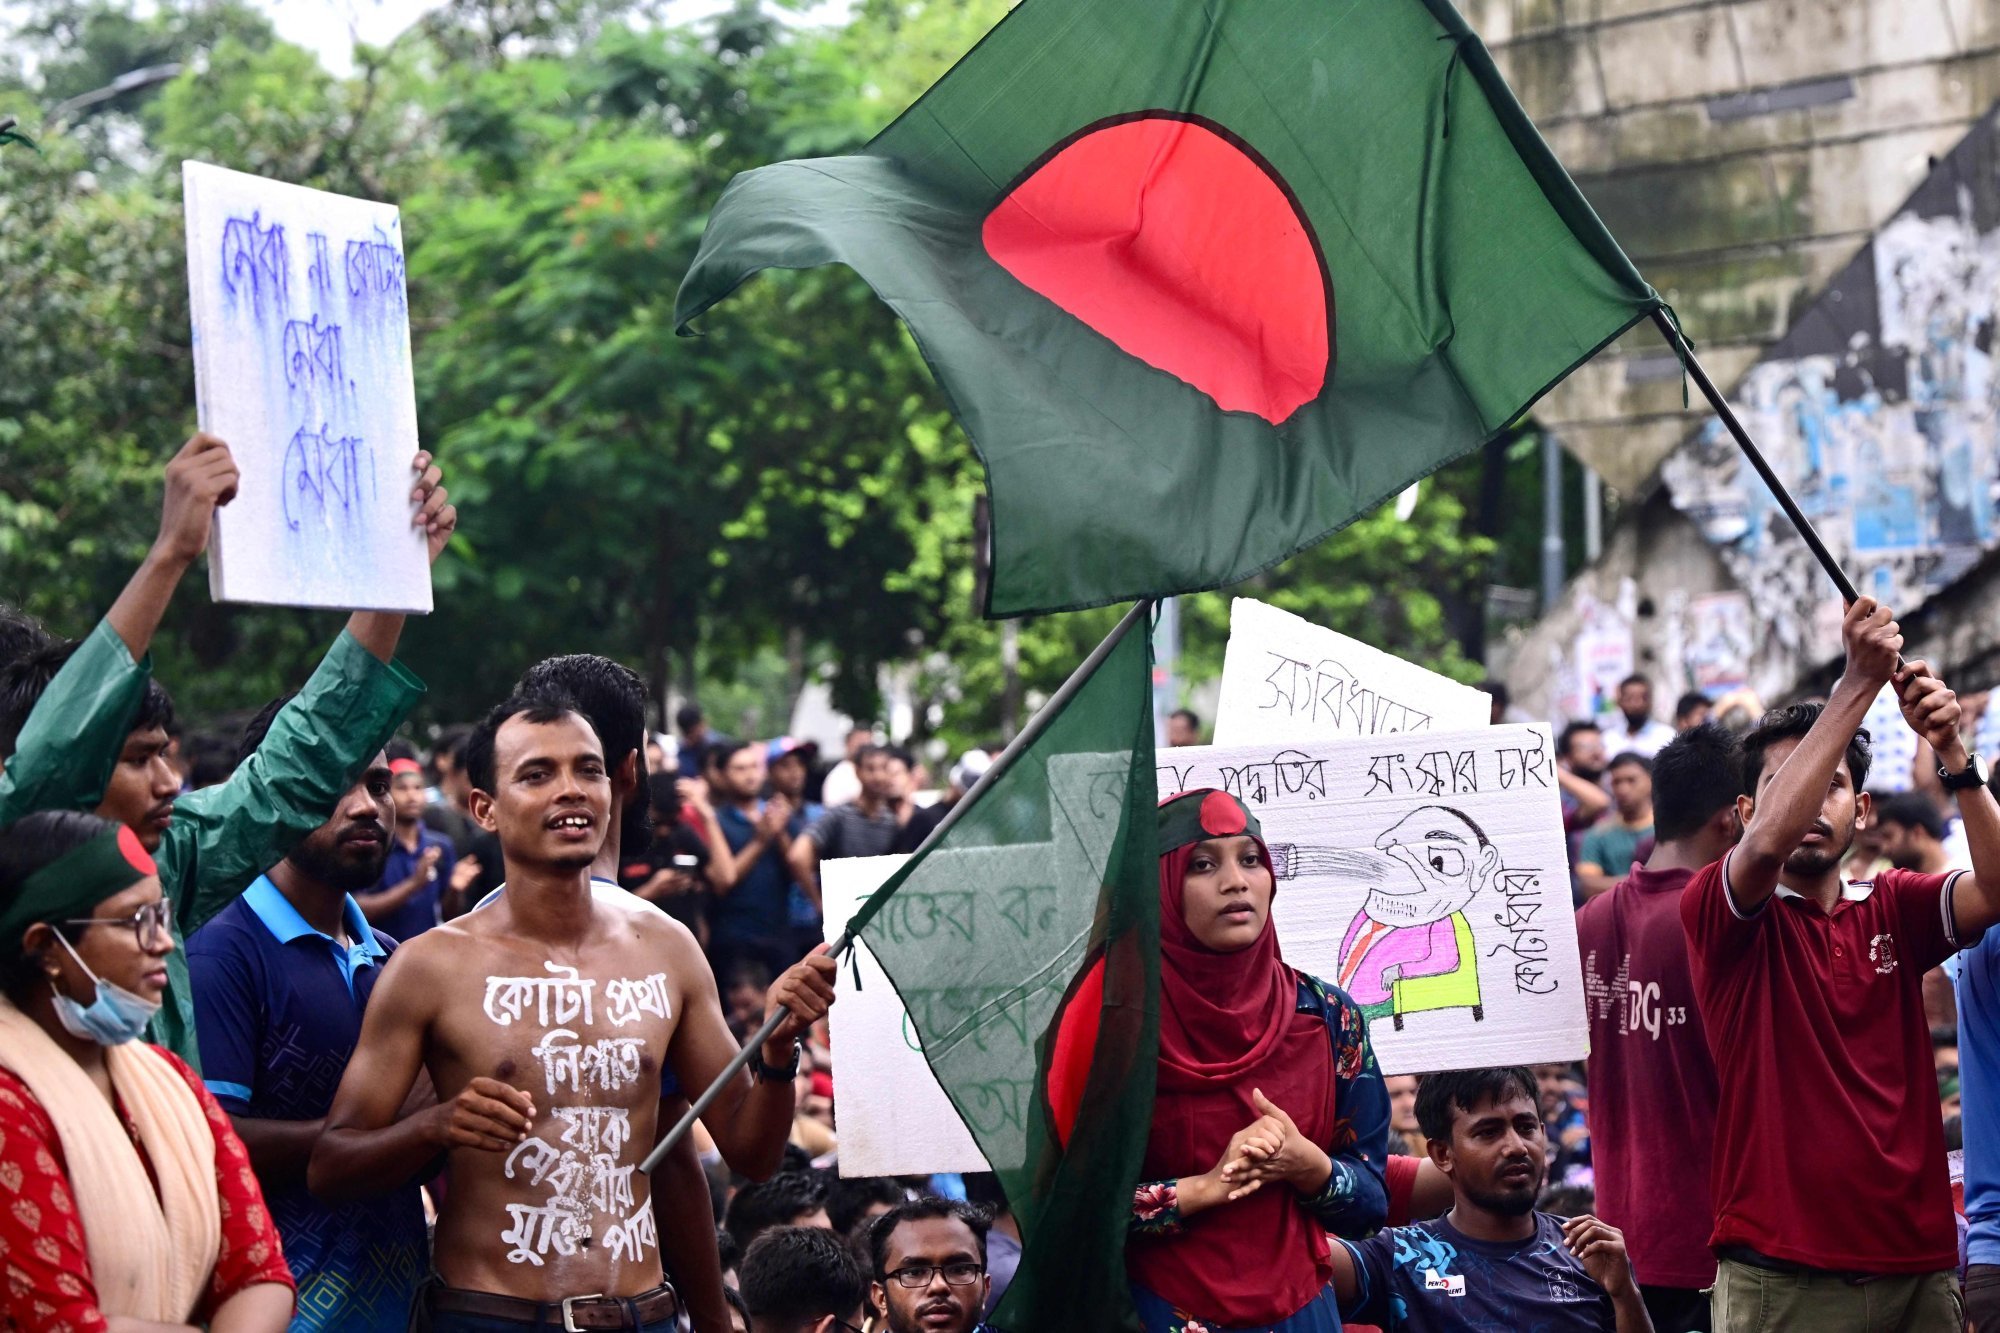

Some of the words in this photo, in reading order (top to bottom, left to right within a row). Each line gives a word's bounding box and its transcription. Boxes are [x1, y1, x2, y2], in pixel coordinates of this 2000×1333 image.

[222, 210, 287, 296] মেধা
[306, 232, 332, 290] না
[1218, 749, 1331, 805] পদ্ধতির
[1363, 750, 1479, 798] সংস্কার
[1486, 857, 1560, 996] কোটাধারী
[483, 960, 597, 1026] কোটা
[605, 972, 672, 1028] প্রথা
[531, 1028, 646, 1095] নিপাত
[551, 1106, 631, 1160] যাক
